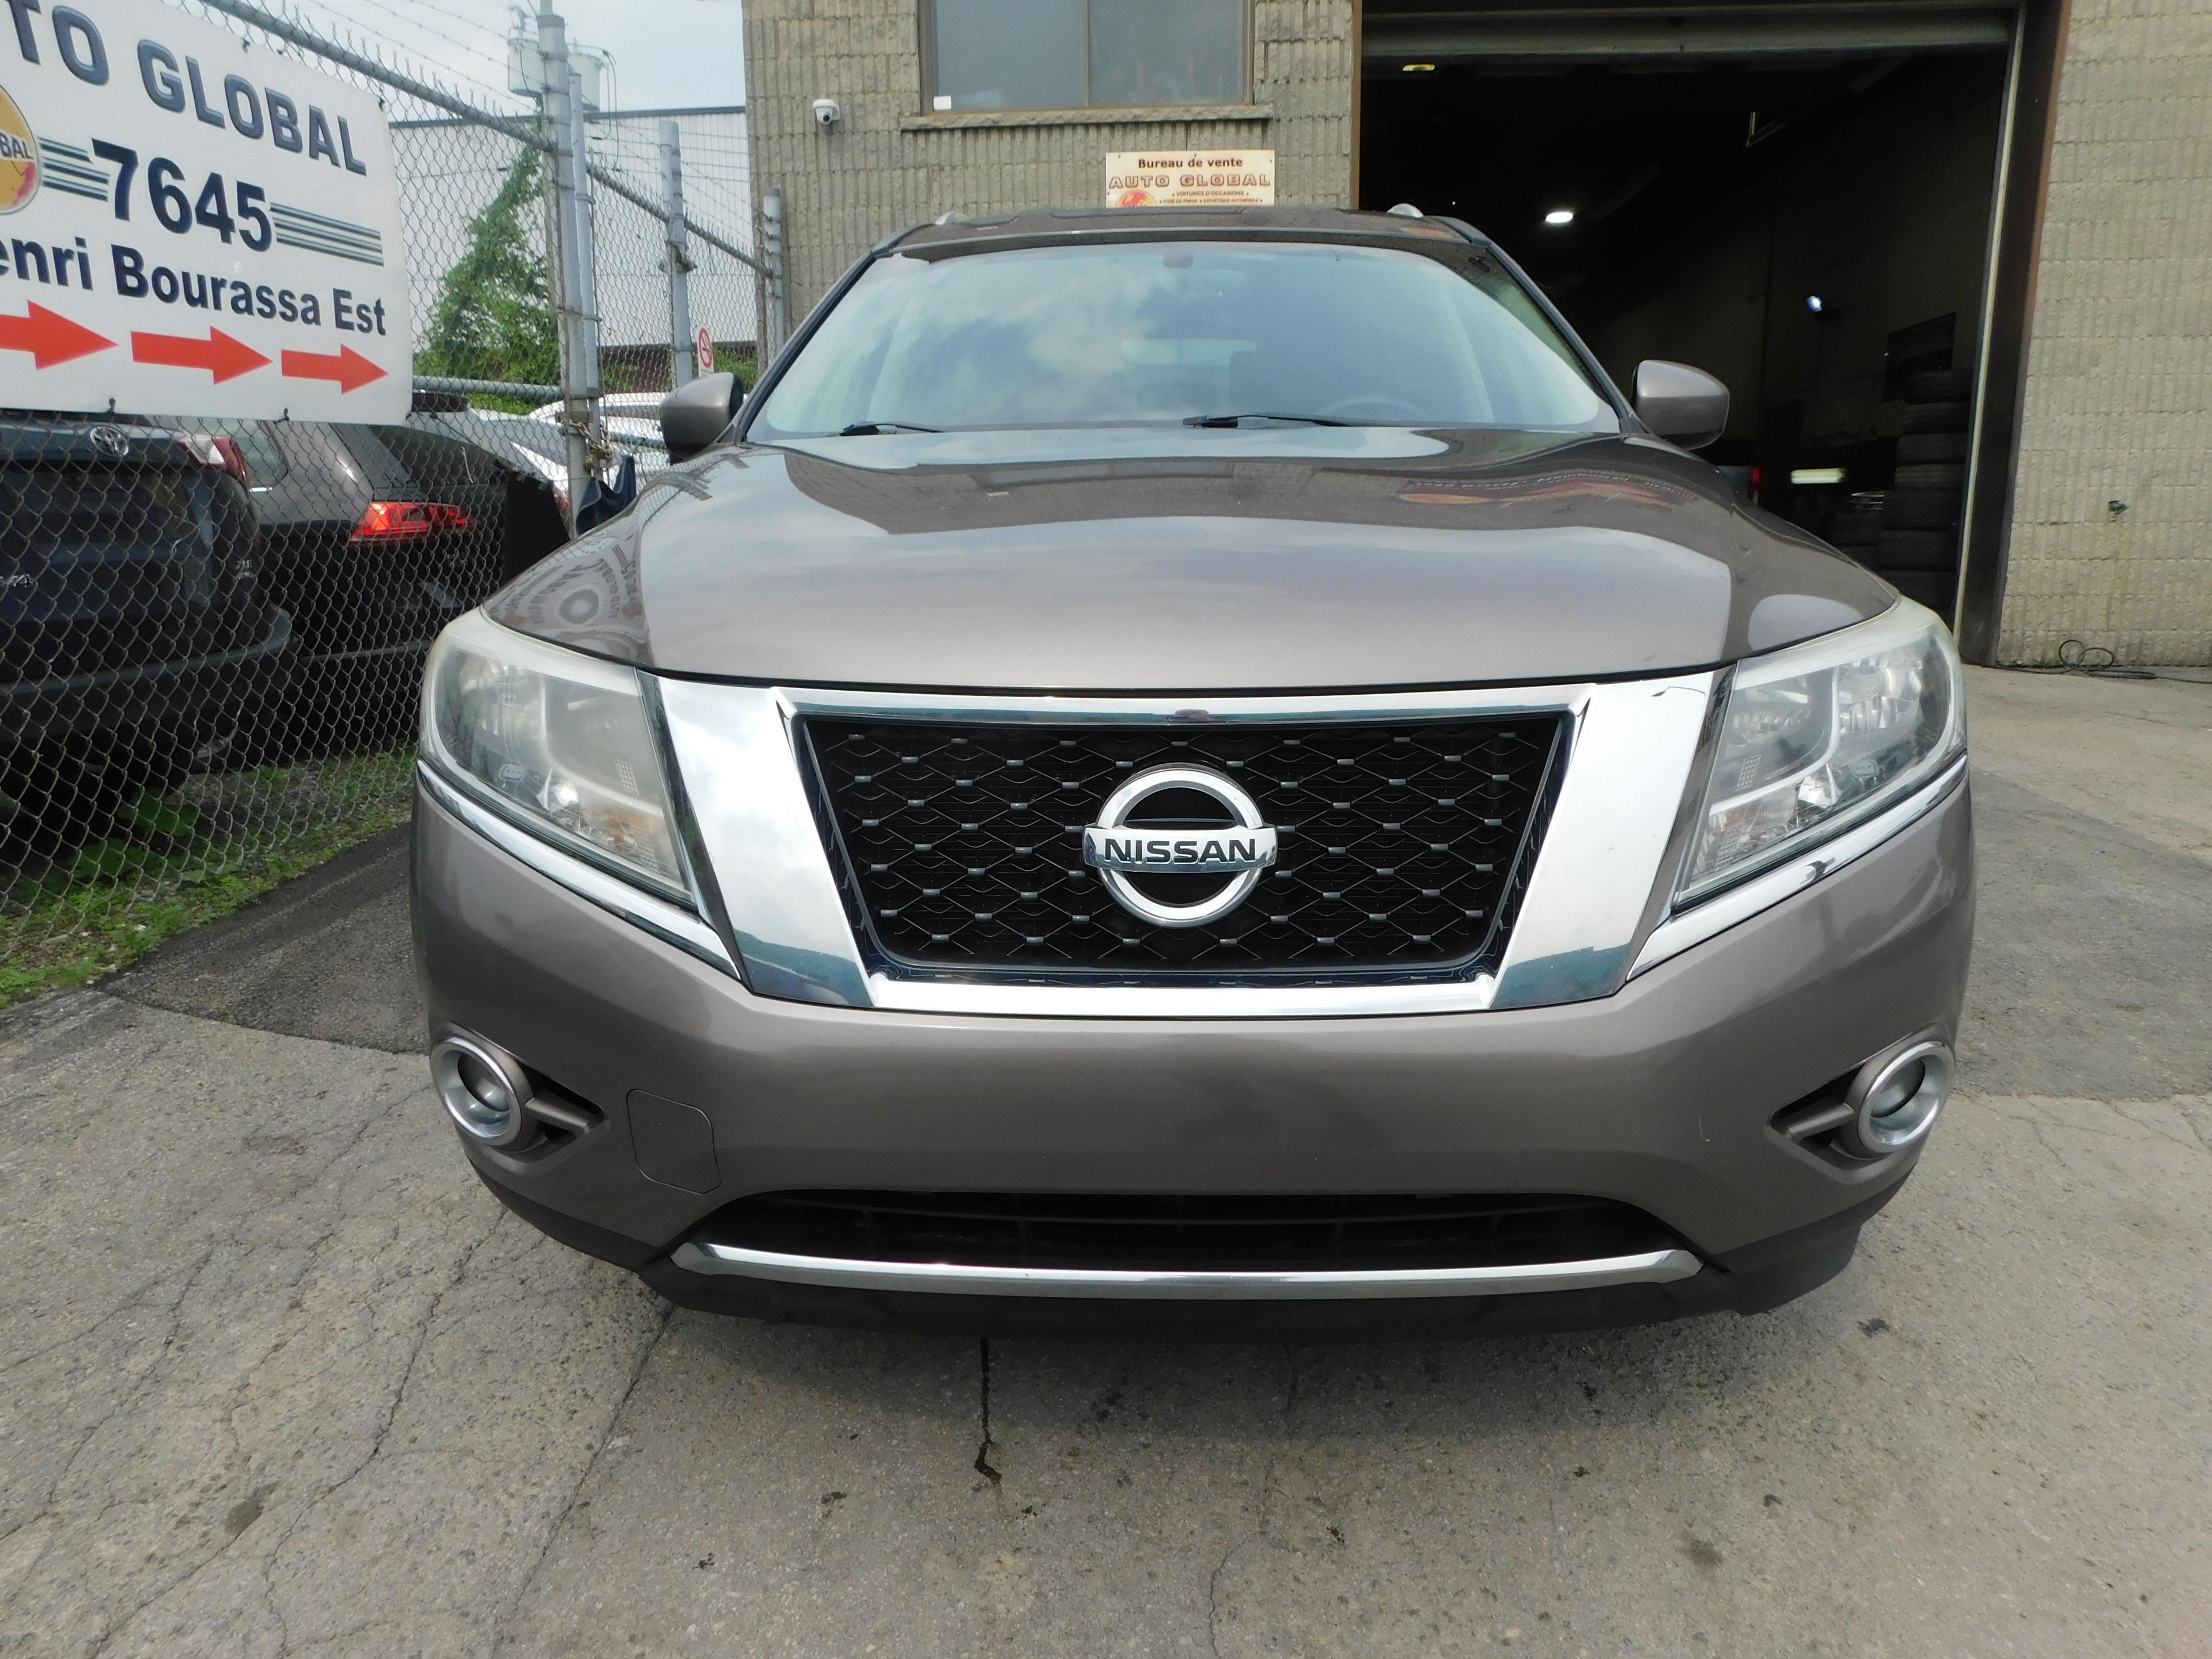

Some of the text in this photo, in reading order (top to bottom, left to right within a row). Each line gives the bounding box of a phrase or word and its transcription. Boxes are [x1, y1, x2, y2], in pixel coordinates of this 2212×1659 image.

[137, 39, 368, 176] GLOBAL
[1109, 174, 1271, 189] AUTO GLOBAL
[1138, 158, 1243, 169] Bureau de vente
[92, 138, 273, 252] 7645
[111, 244, 321, 326] Bourassa
[332, 288, 387, 336] Est
[1104, 838, 1256, 864] NISSAN
